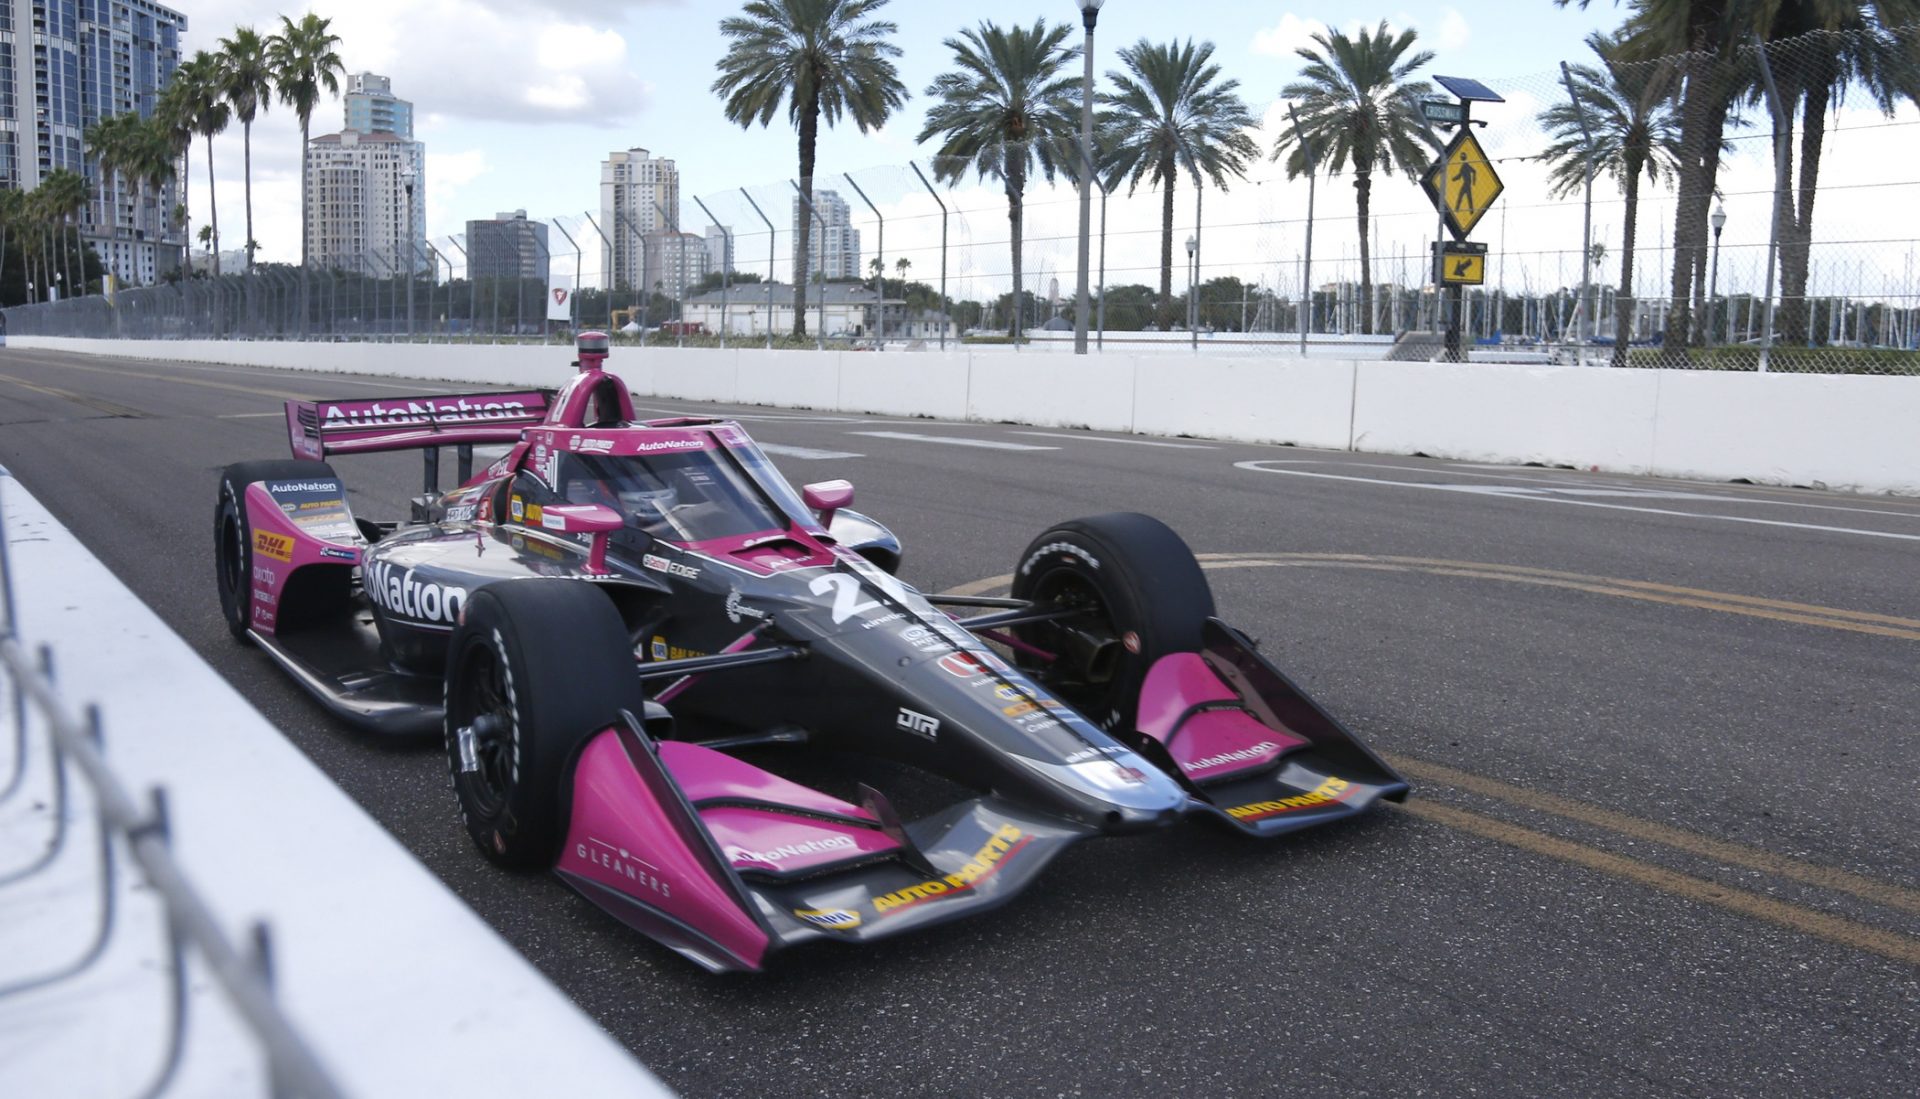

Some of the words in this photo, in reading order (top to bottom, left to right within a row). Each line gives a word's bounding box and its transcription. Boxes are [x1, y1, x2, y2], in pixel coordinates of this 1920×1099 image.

[324, 399, 525, 427] AutoNation
[637, 440, 704, 451] AutoNation
[272, 482, 336, 493] AutoNation
[258, 534, 286, 556] DHL
[669, 562, 701, 579] EDGE
[367, 561, 467, 622] oNation
[1183, 741, 1280, 772] AutoNation
[1225, 799, 1283, 819] AUTO
[1281, 776, 1350, 808] PARTS
[726, 835, 857, 863] AutoNation
[576, 844, 671, 897] GLEANERS
[871, 881, 946, 912] AUTO
[946, 824, 1022, 888] PARTS
